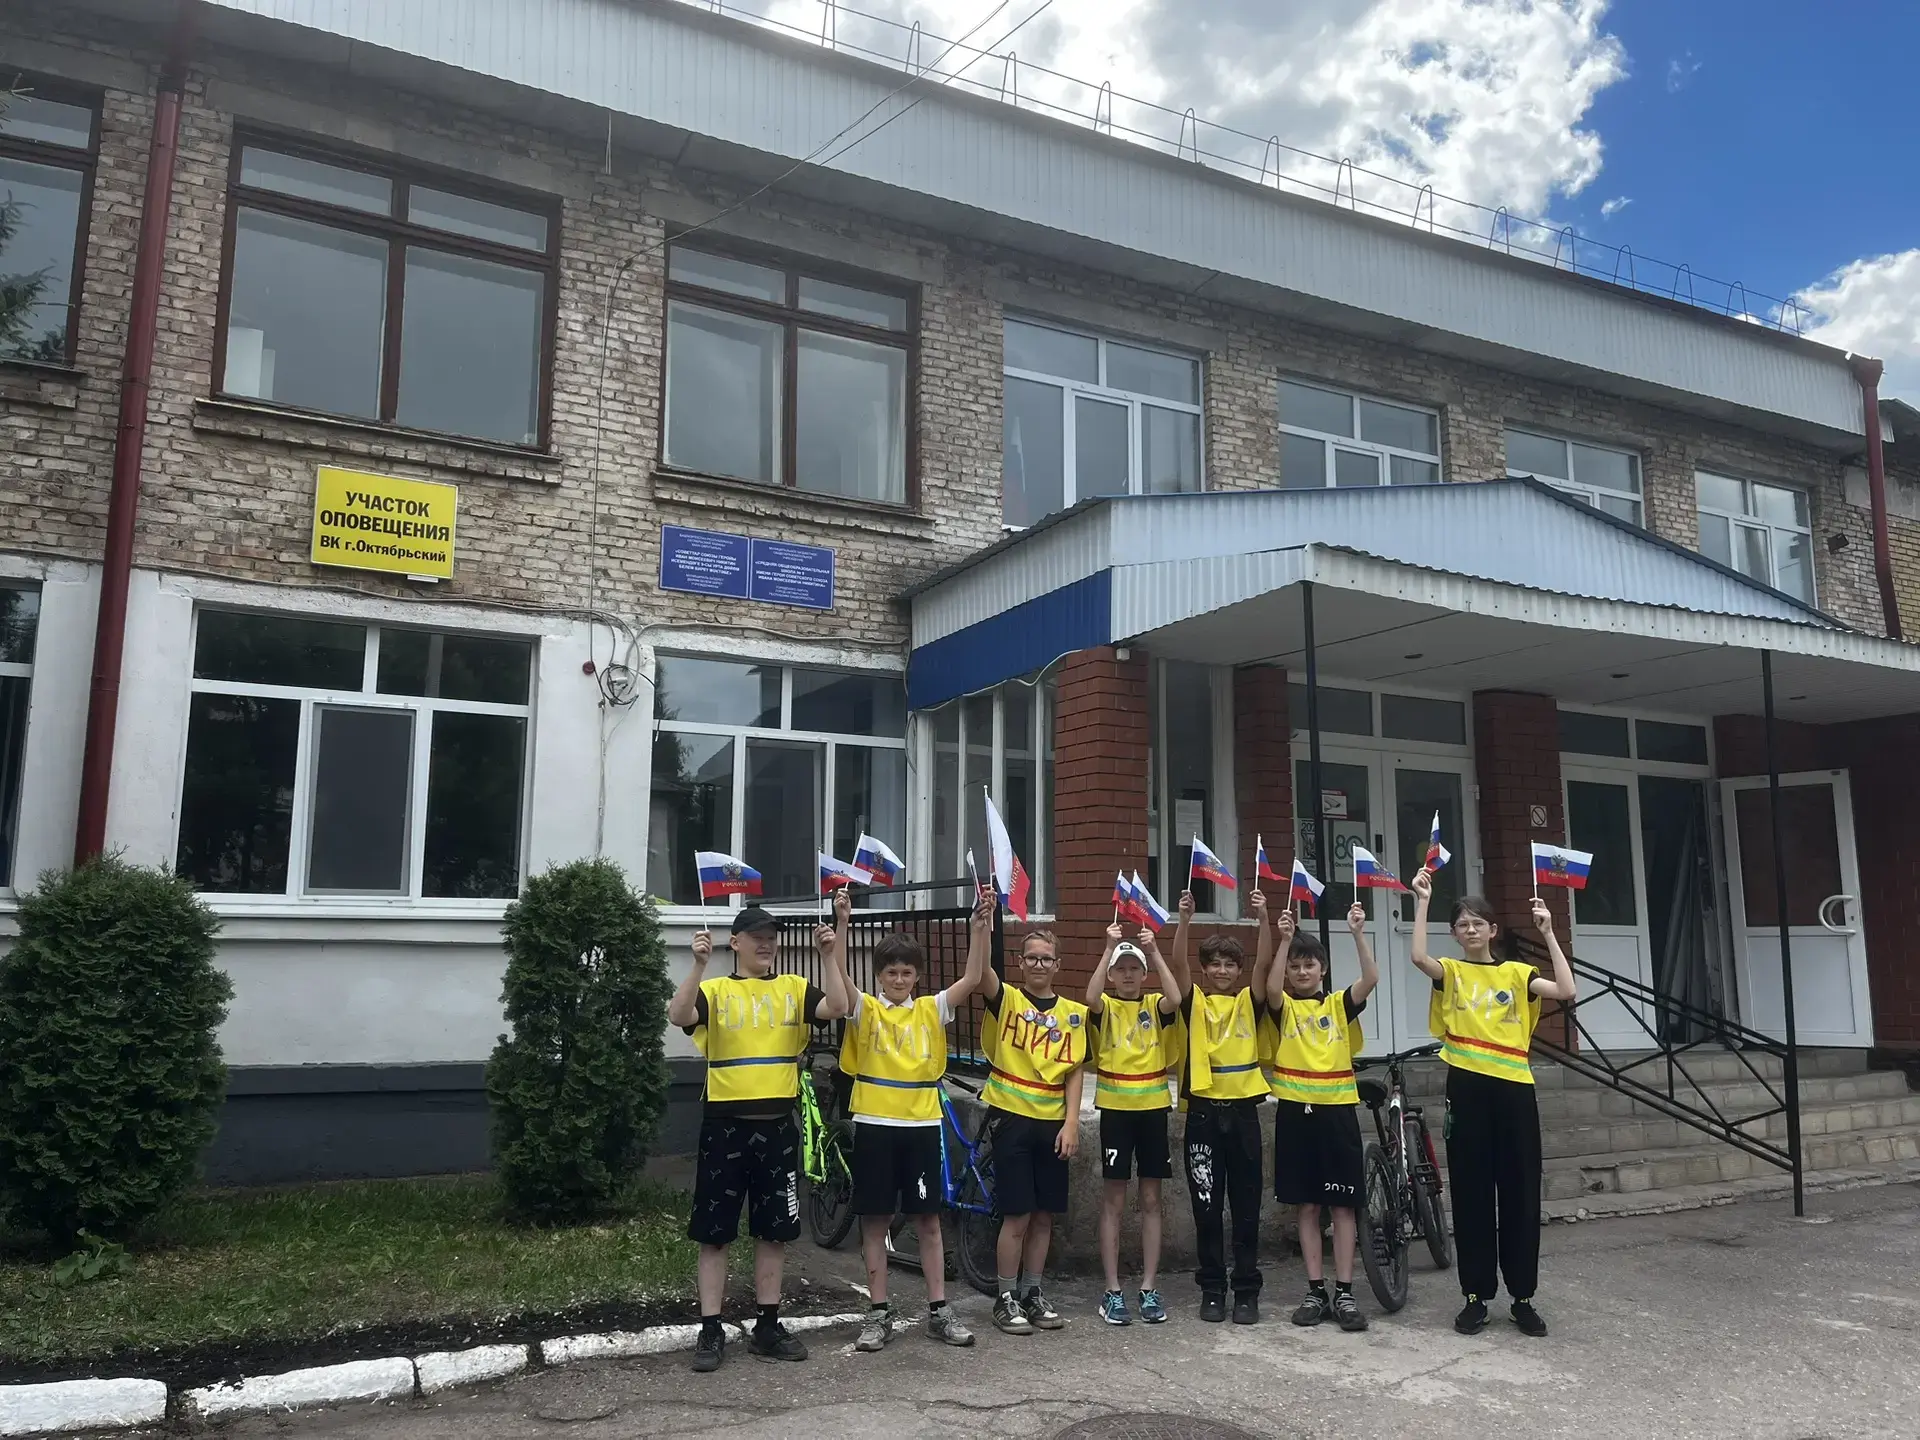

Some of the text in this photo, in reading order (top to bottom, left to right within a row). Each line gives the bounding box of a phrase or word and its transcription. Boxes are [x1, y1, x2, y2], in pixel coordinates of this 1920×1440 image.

[345, 490, 430, 518] УЧАСТОК
[320, 509, 450, 541] ОПОВЕЩЕНИЯ
[320, 535, 446, 562] ВК г.Октябрьский
[1001, 1010, 1075, 1064] ЮИД
